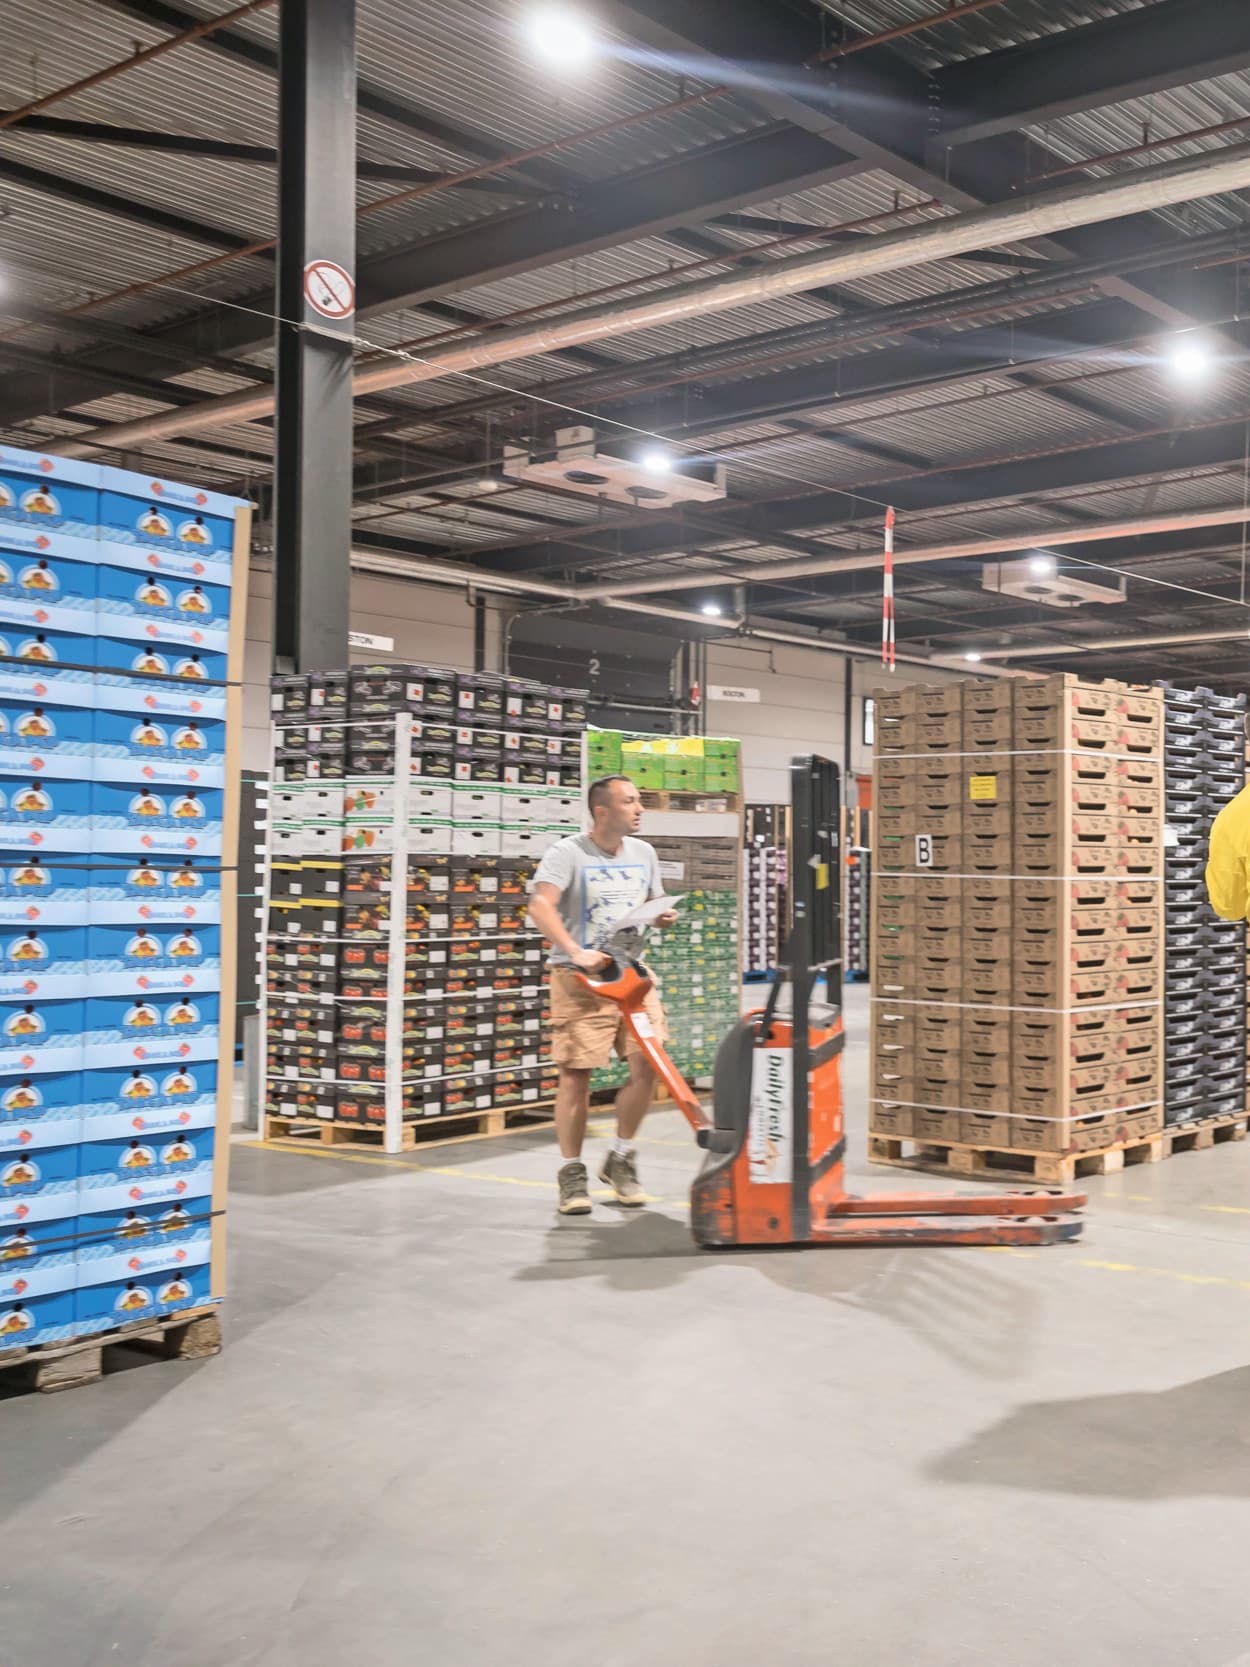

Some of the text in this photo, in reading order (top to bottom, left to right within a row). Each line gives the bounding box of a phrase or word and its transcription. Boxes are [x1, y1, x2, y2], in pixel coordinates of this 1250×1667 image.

[589, 659, 600, 675] 2
[918, 836, 930, 863] B
[764, 1054, 783, 1142] DailyFresh
